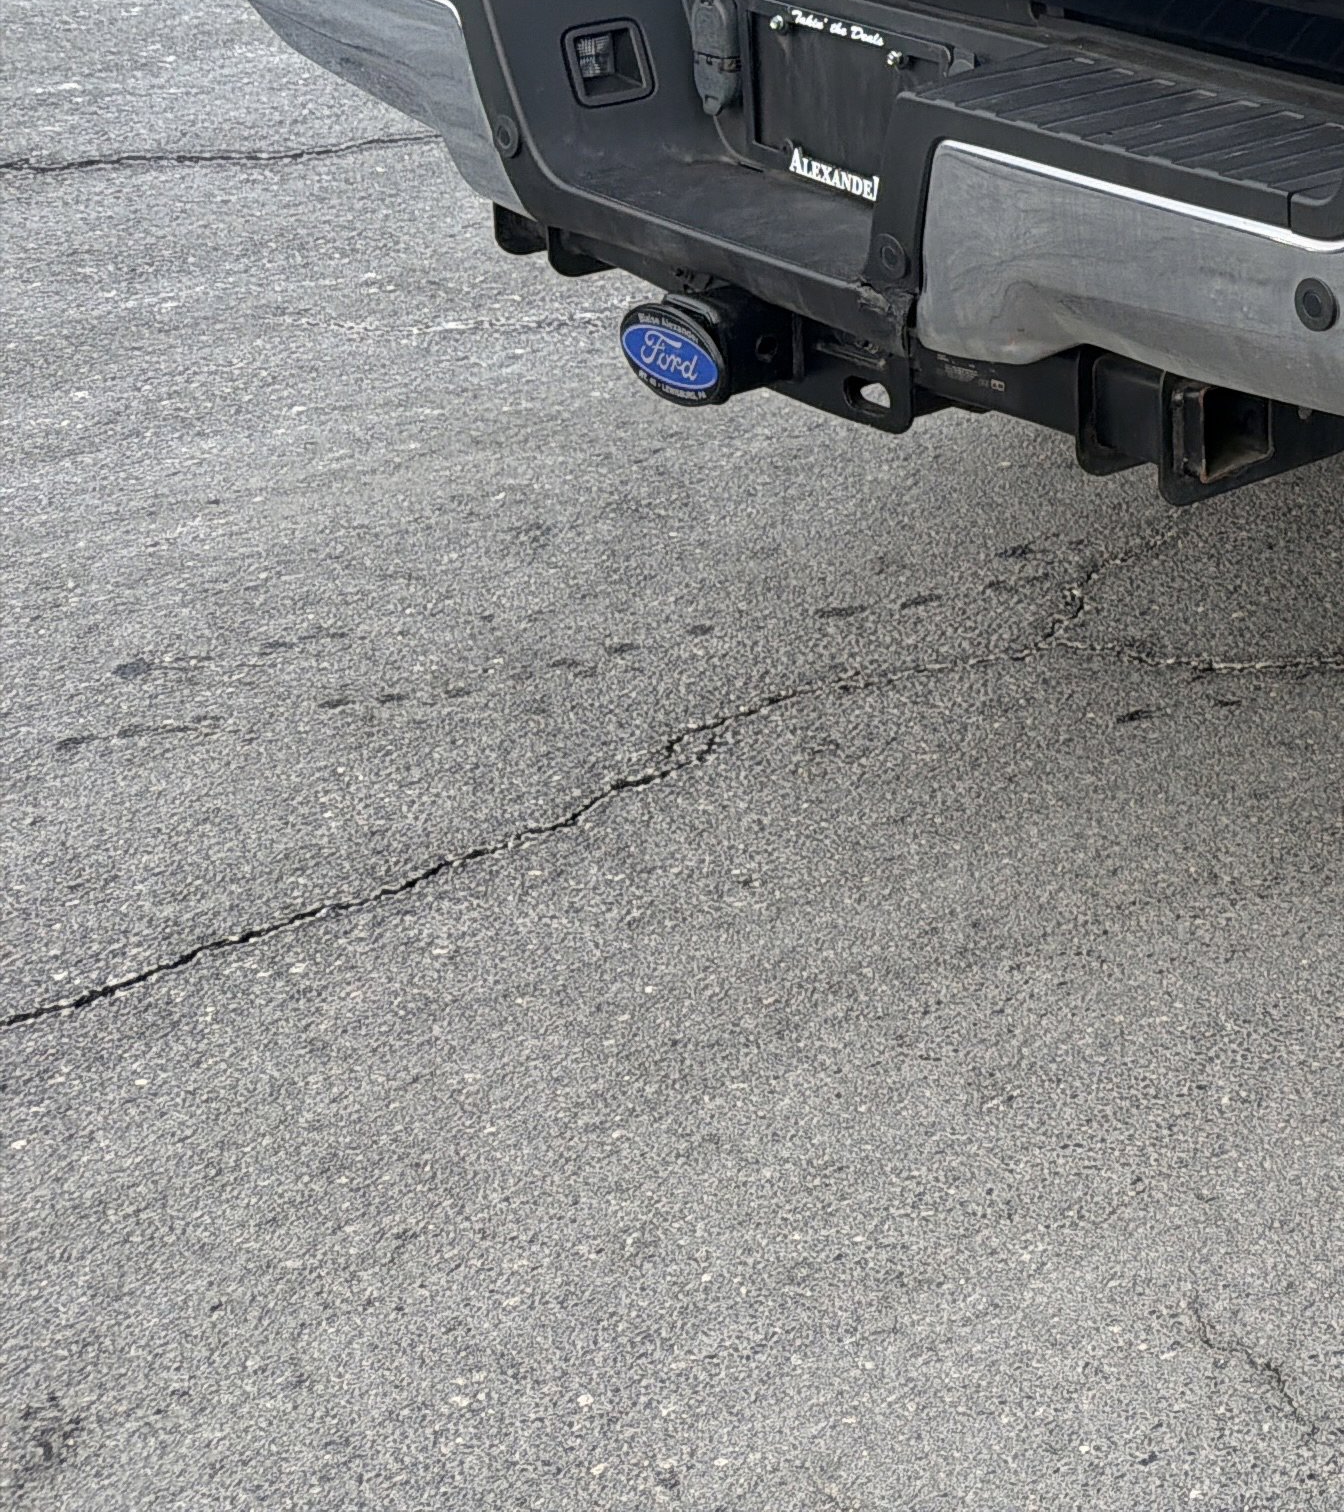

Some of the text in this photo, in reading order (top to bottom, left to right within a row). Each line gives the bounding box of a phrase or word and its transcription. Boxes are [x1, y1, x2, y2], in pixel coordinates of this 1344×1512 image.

[829, 22, 848, 37] the
[850, 25, 885, 47] Deals
[640, 330, 699, 381] Ford
